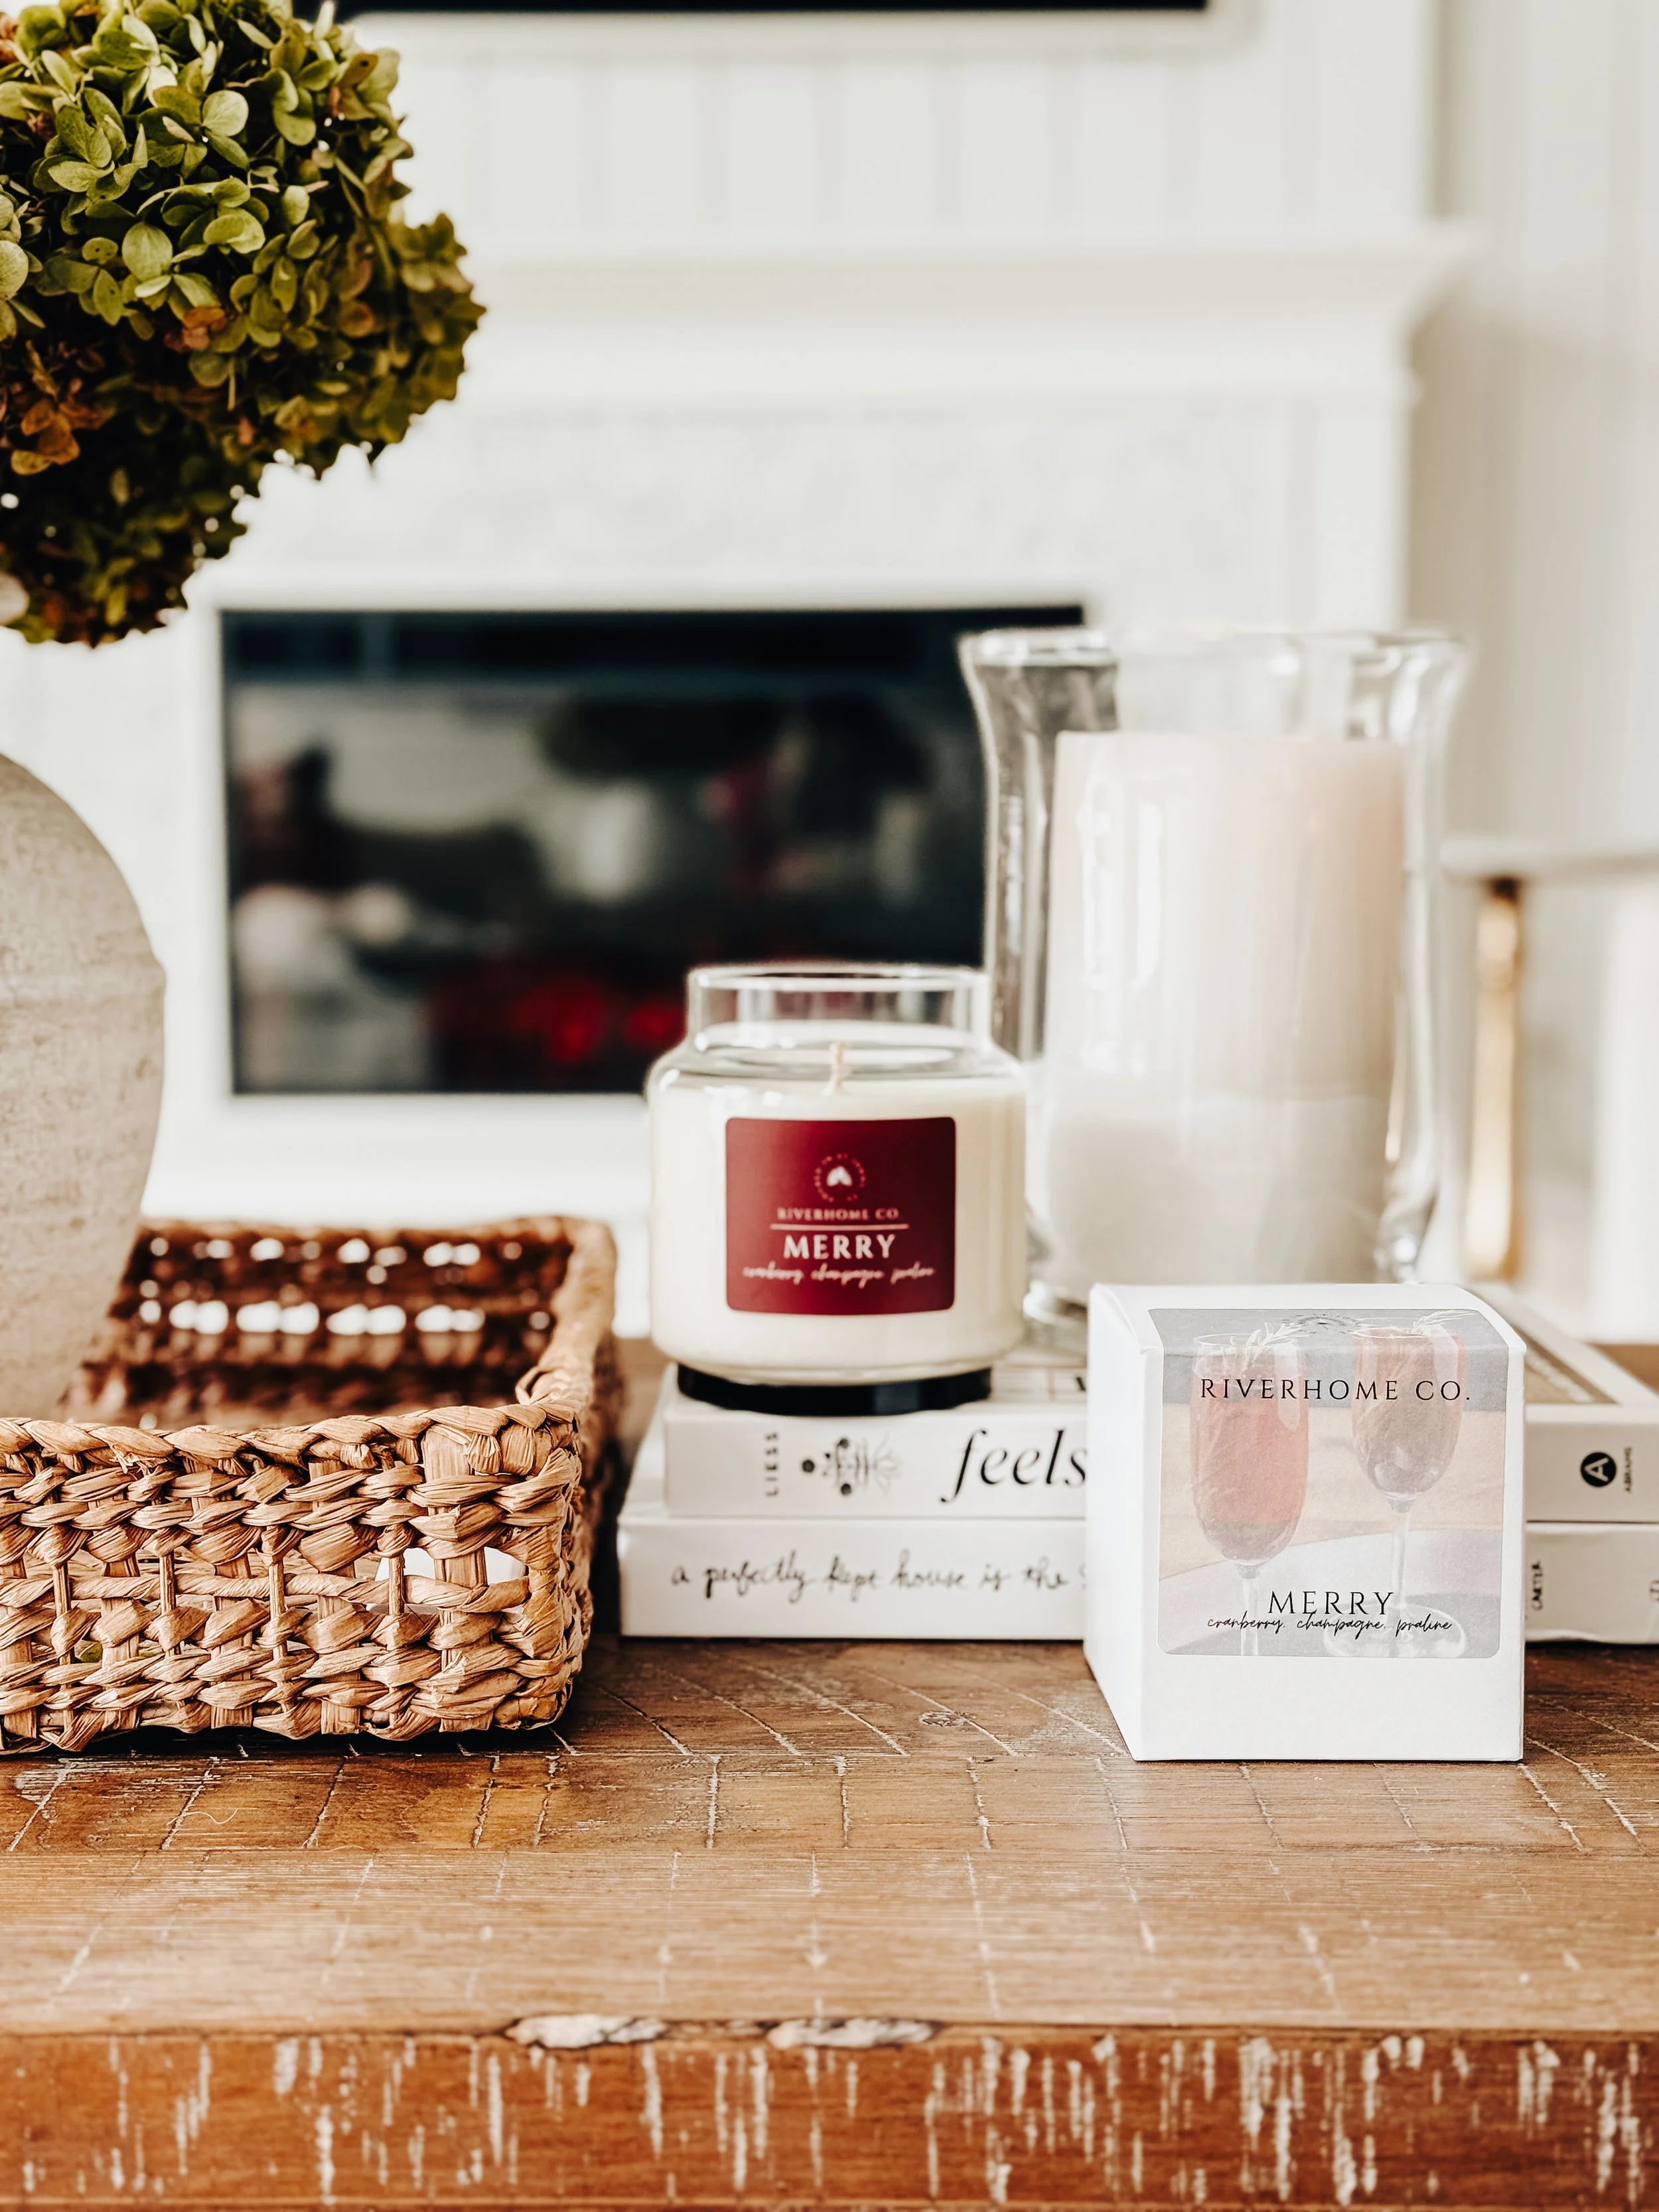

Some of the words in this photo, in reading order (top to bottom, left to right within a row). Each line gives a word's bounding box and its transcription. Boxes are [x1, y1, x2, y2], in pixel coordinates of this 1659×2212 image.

[776, 1207, 869, 1220] RIVERHOME
[783, 1234, 896, 1260] MERRY
[1200, 1378, 1398, 1400] RIVERHOME
[1415, 1380, 1471, 1401] CO.
[764, 1431, 780, 1497] LIESS
[939, 1426, 1087, 1503] feels
[671, 1565, 691, 1585] a
[701, 1549, 816, 1604] perfectly
[822, 1556, 883, 1601] kept
[889, 1547, 967, 1589] house
[979, 1562, 1011, 1592] is
[1021, 1555, 1070, 1589] the
[1267, 1590, 1394, 1615] MERRY
[1395, 1613, 1453, 1637] praline
